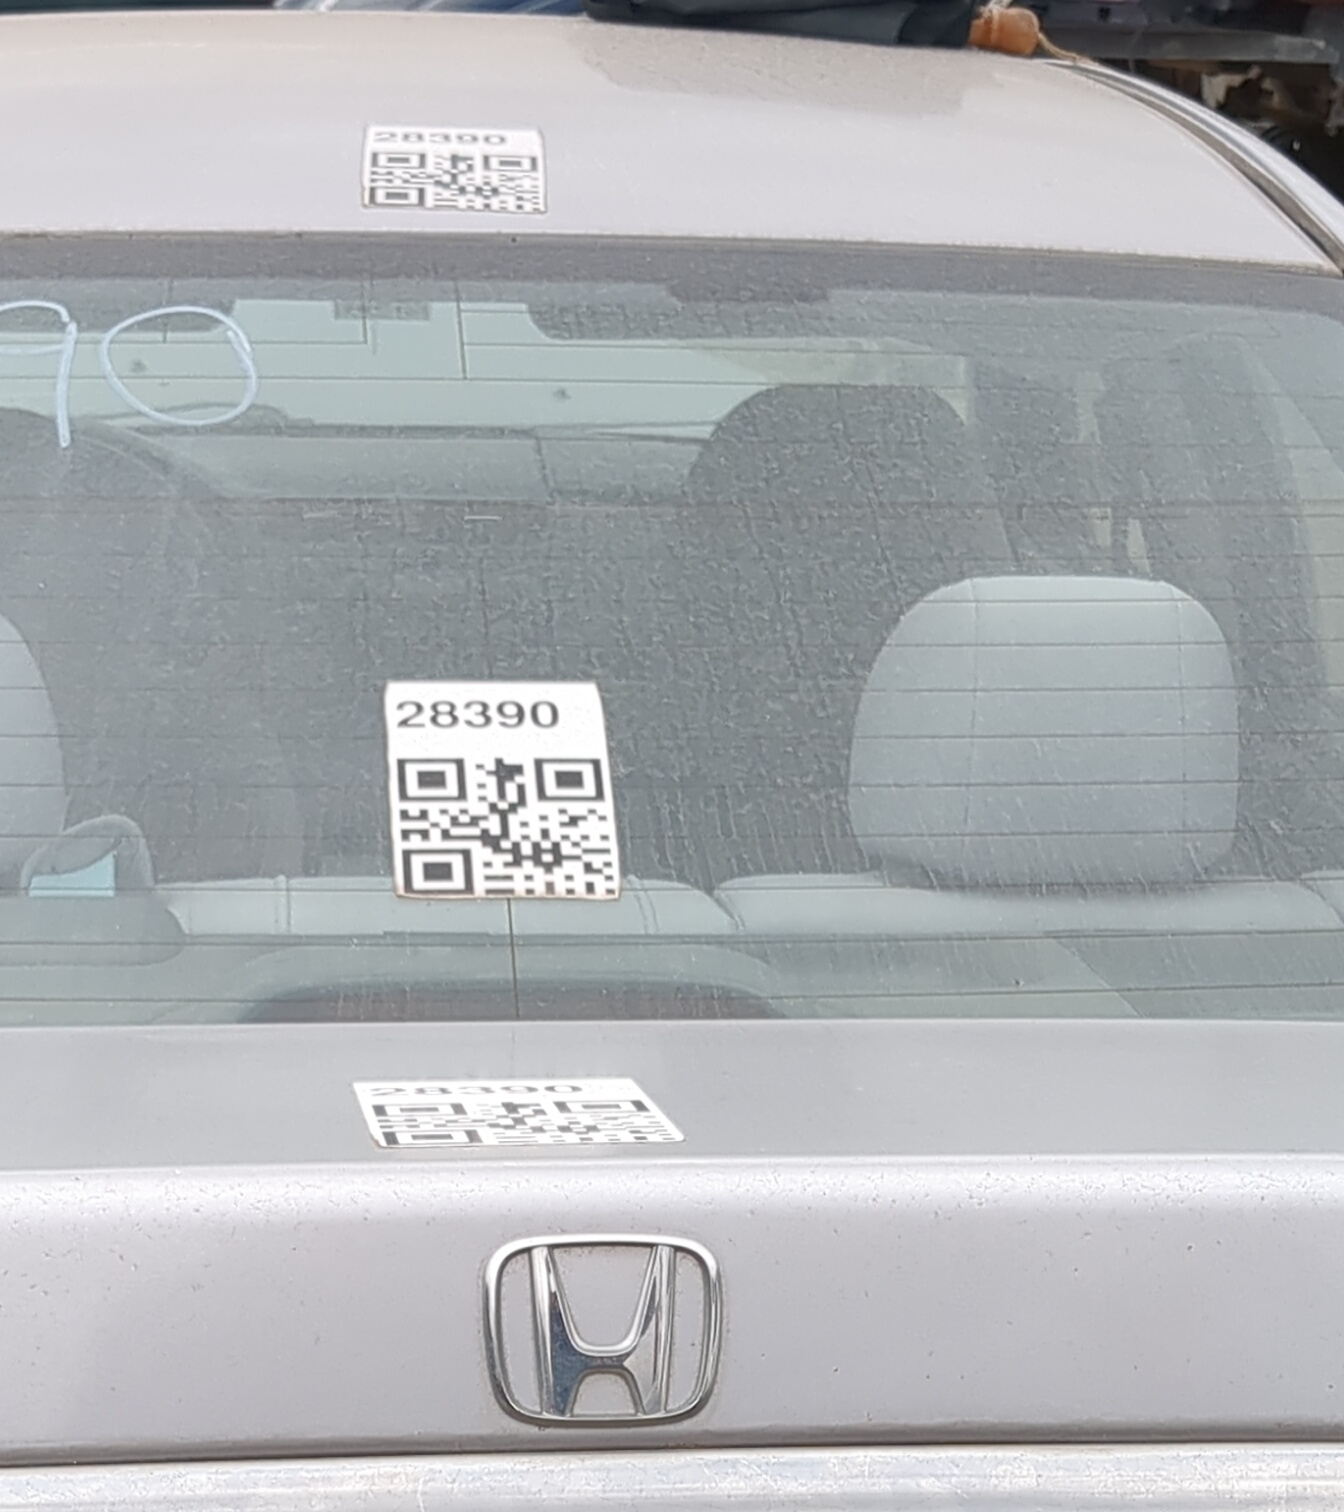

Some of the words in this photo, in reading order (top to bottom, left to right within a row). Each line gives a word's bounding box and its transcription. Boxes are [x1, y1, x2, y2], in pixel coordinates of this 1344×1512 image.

[373, 131, 506, 146] 28390
[396, 700, 560, 729] 28390
[370, 1084, 584, 1096] 28390
